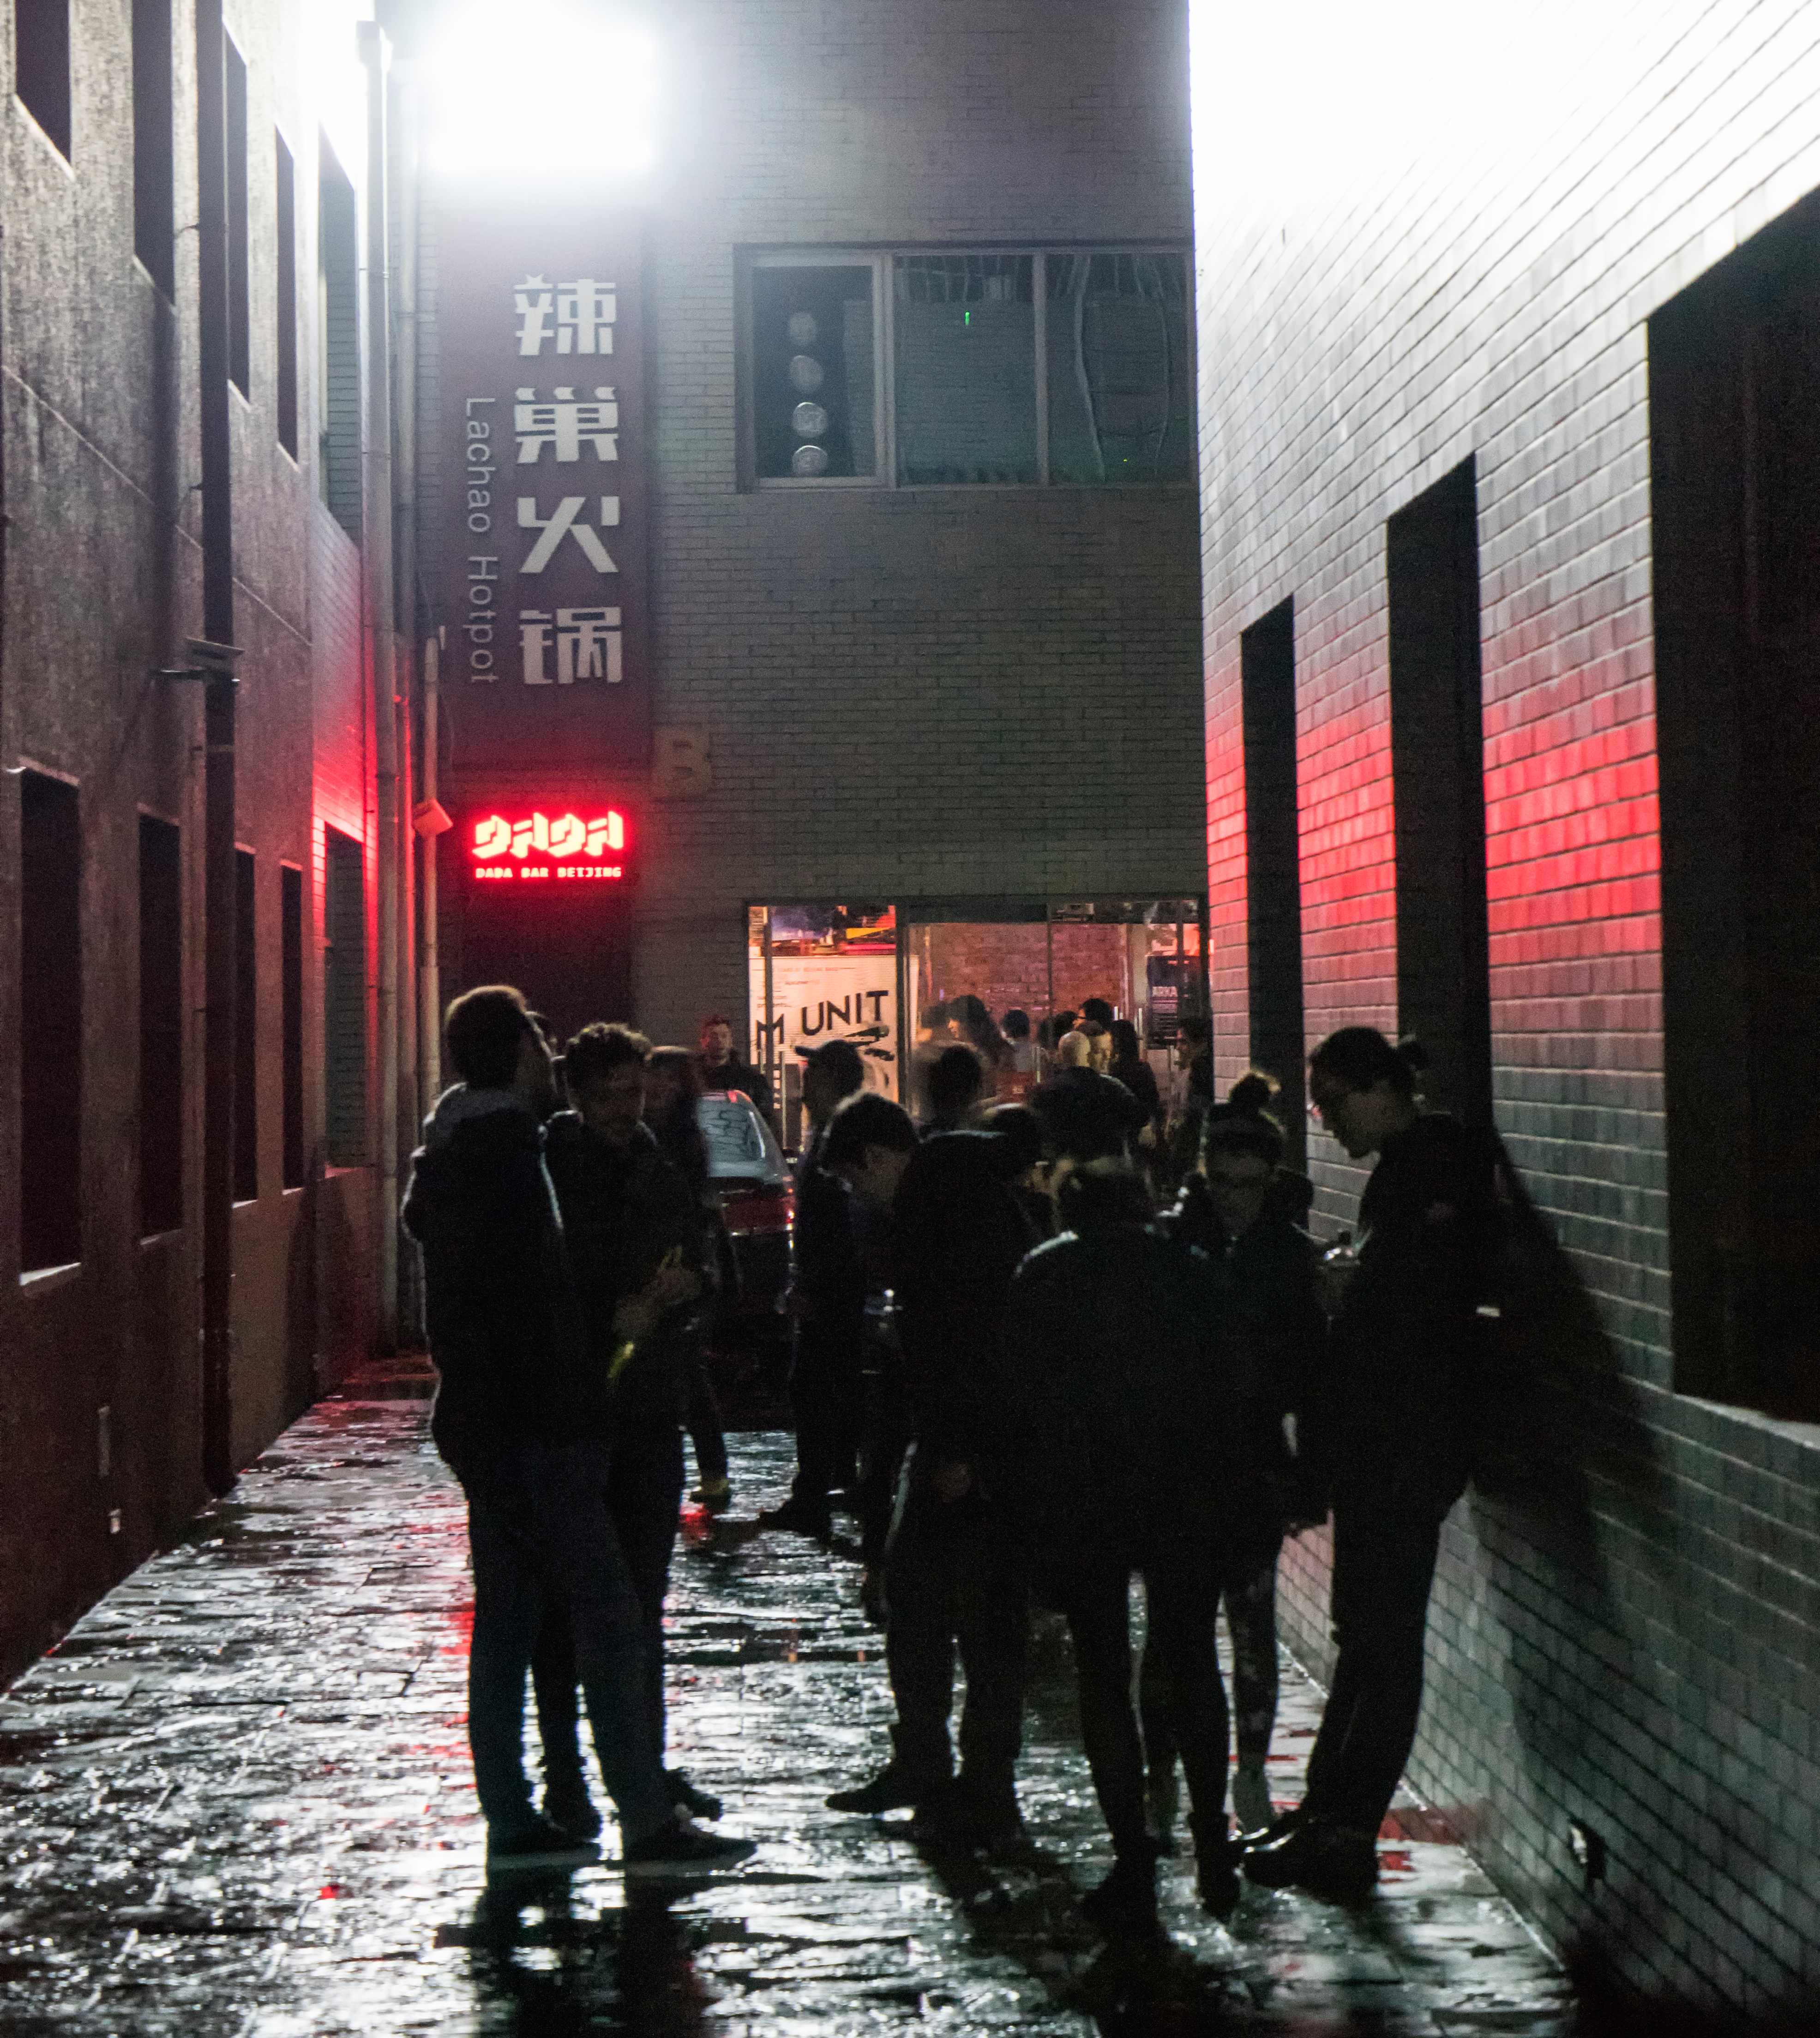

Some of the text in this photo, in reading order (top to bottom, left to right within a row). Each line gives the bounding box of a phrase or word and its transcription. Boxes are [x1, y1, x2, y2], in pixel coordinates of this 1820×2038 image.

[463, 397, 499, 684] Lachao Hotpot
[513, 274, 622, 684] 辣巢火锅
[475, 867, 622, 878] DADA BAR BEIJING
[801, 989, 889, 1036] UNIT
